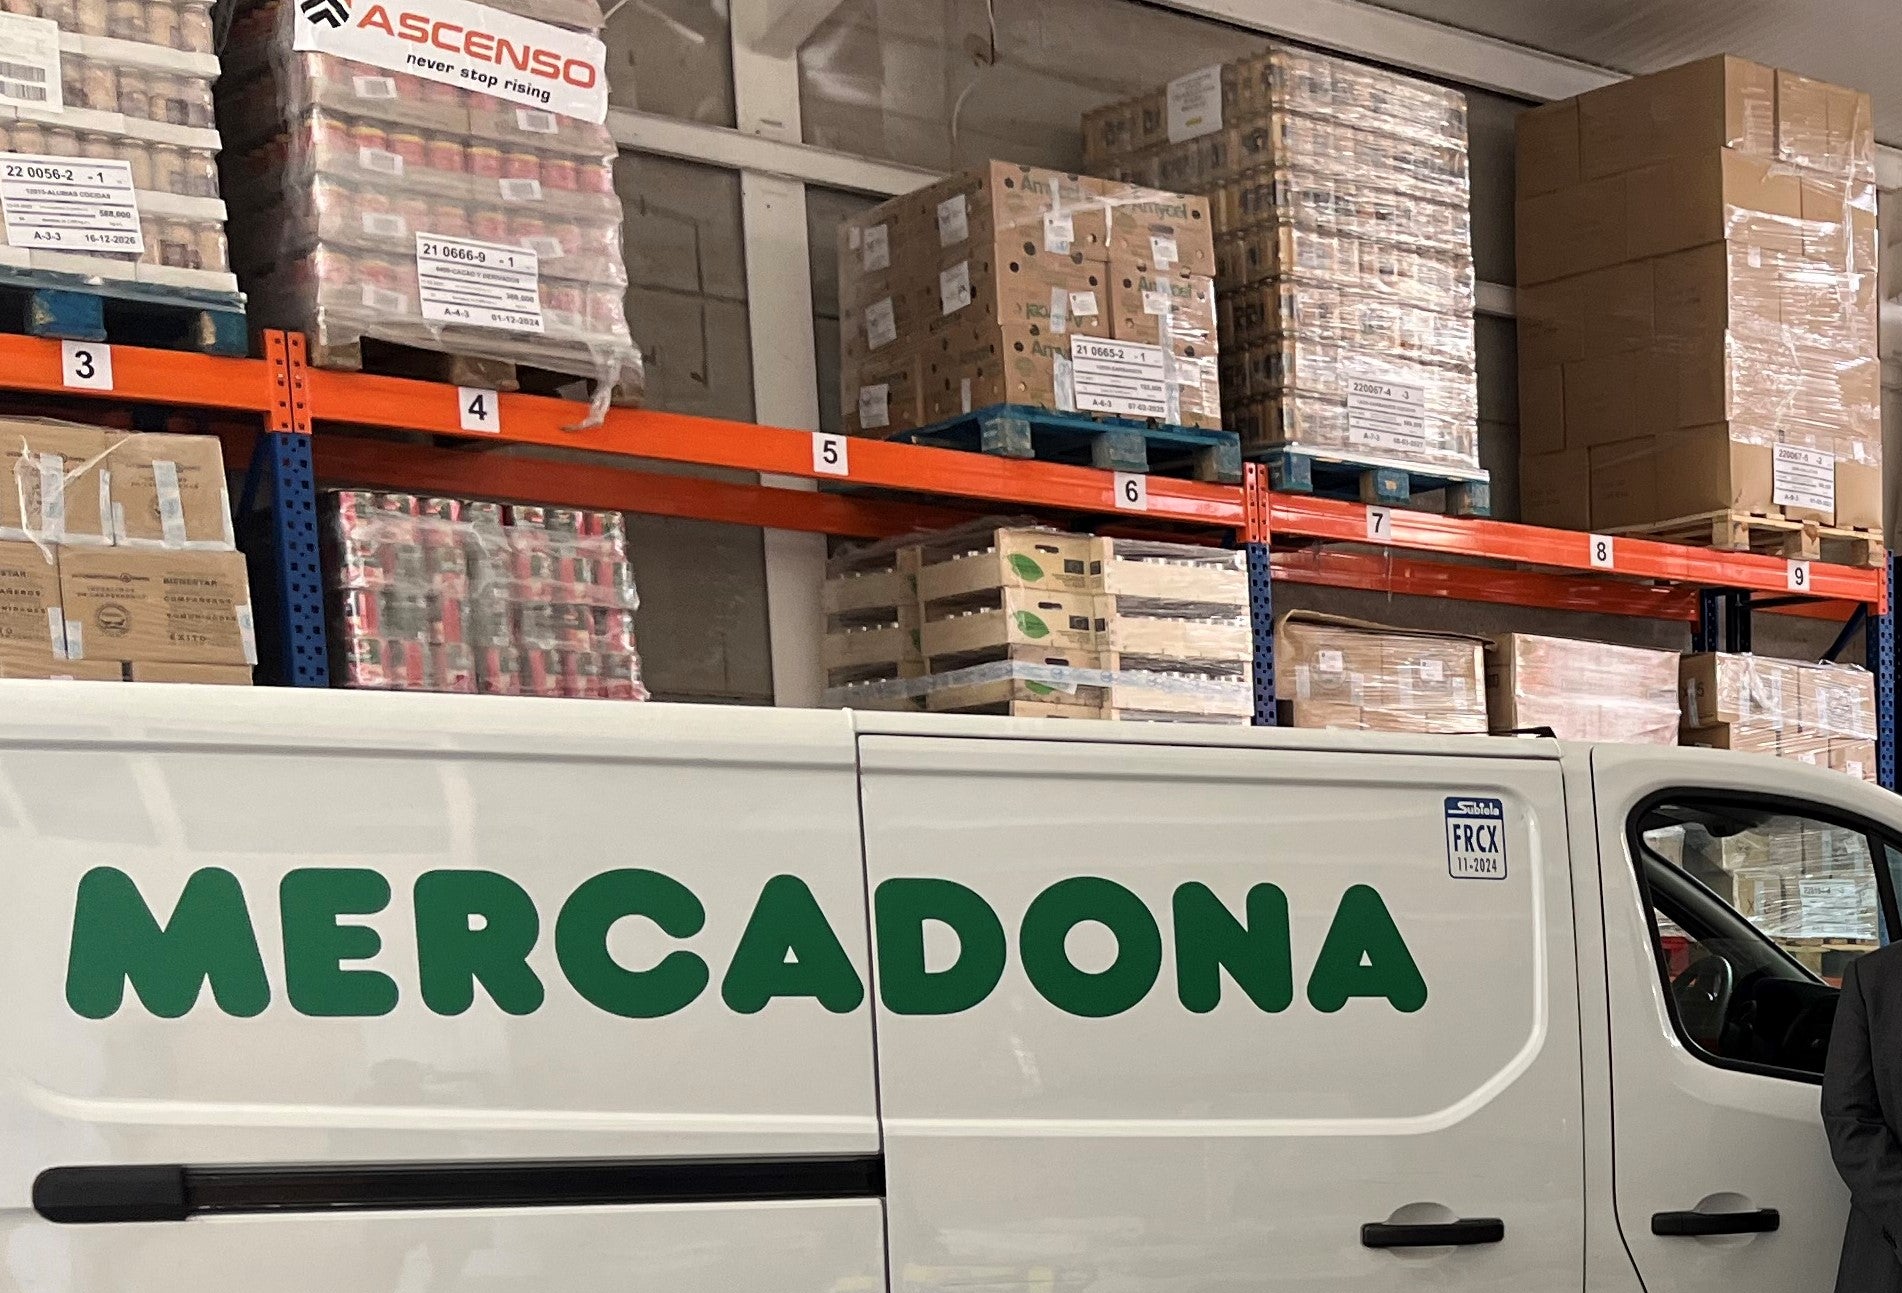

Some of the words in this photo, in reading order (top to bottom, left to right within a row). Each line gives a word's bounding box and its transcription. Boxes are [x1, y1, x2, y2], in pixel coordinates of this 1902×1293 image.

[357, 5, 596, 89] ASCENSO
[406, 52, 454, 73] never
[460, 66, 498, 87] stop
[504, 78, 551, 103] rising
[6, 165, 23, 177] 22
[27, 167, 74, 181] 0056-2
[34, 231, 61, 241] A-3-3
[85, 234, 136, 244] 16-12-2026
[423, 243, 437, 256] 21
[443, 246, 486, 262] 0666-9
[1076, 344, 1088, 355] 21
[75, 350, 96, 379] 3
[467, 395, 487, 420] 4
[823, 441, 838, 465] 5
[1124, 482, 1139, 501] 6
[1372, 514, 1382, 533] 7
[1596, 542, 1606, 561] 8
[1794, 567, 1804, 585] 9
[1453, 824, 1499, 853] FRCX
[1458, 857, 1498, 873] 11-2024
[65, 867, 1428, 1019] MERCADONA
